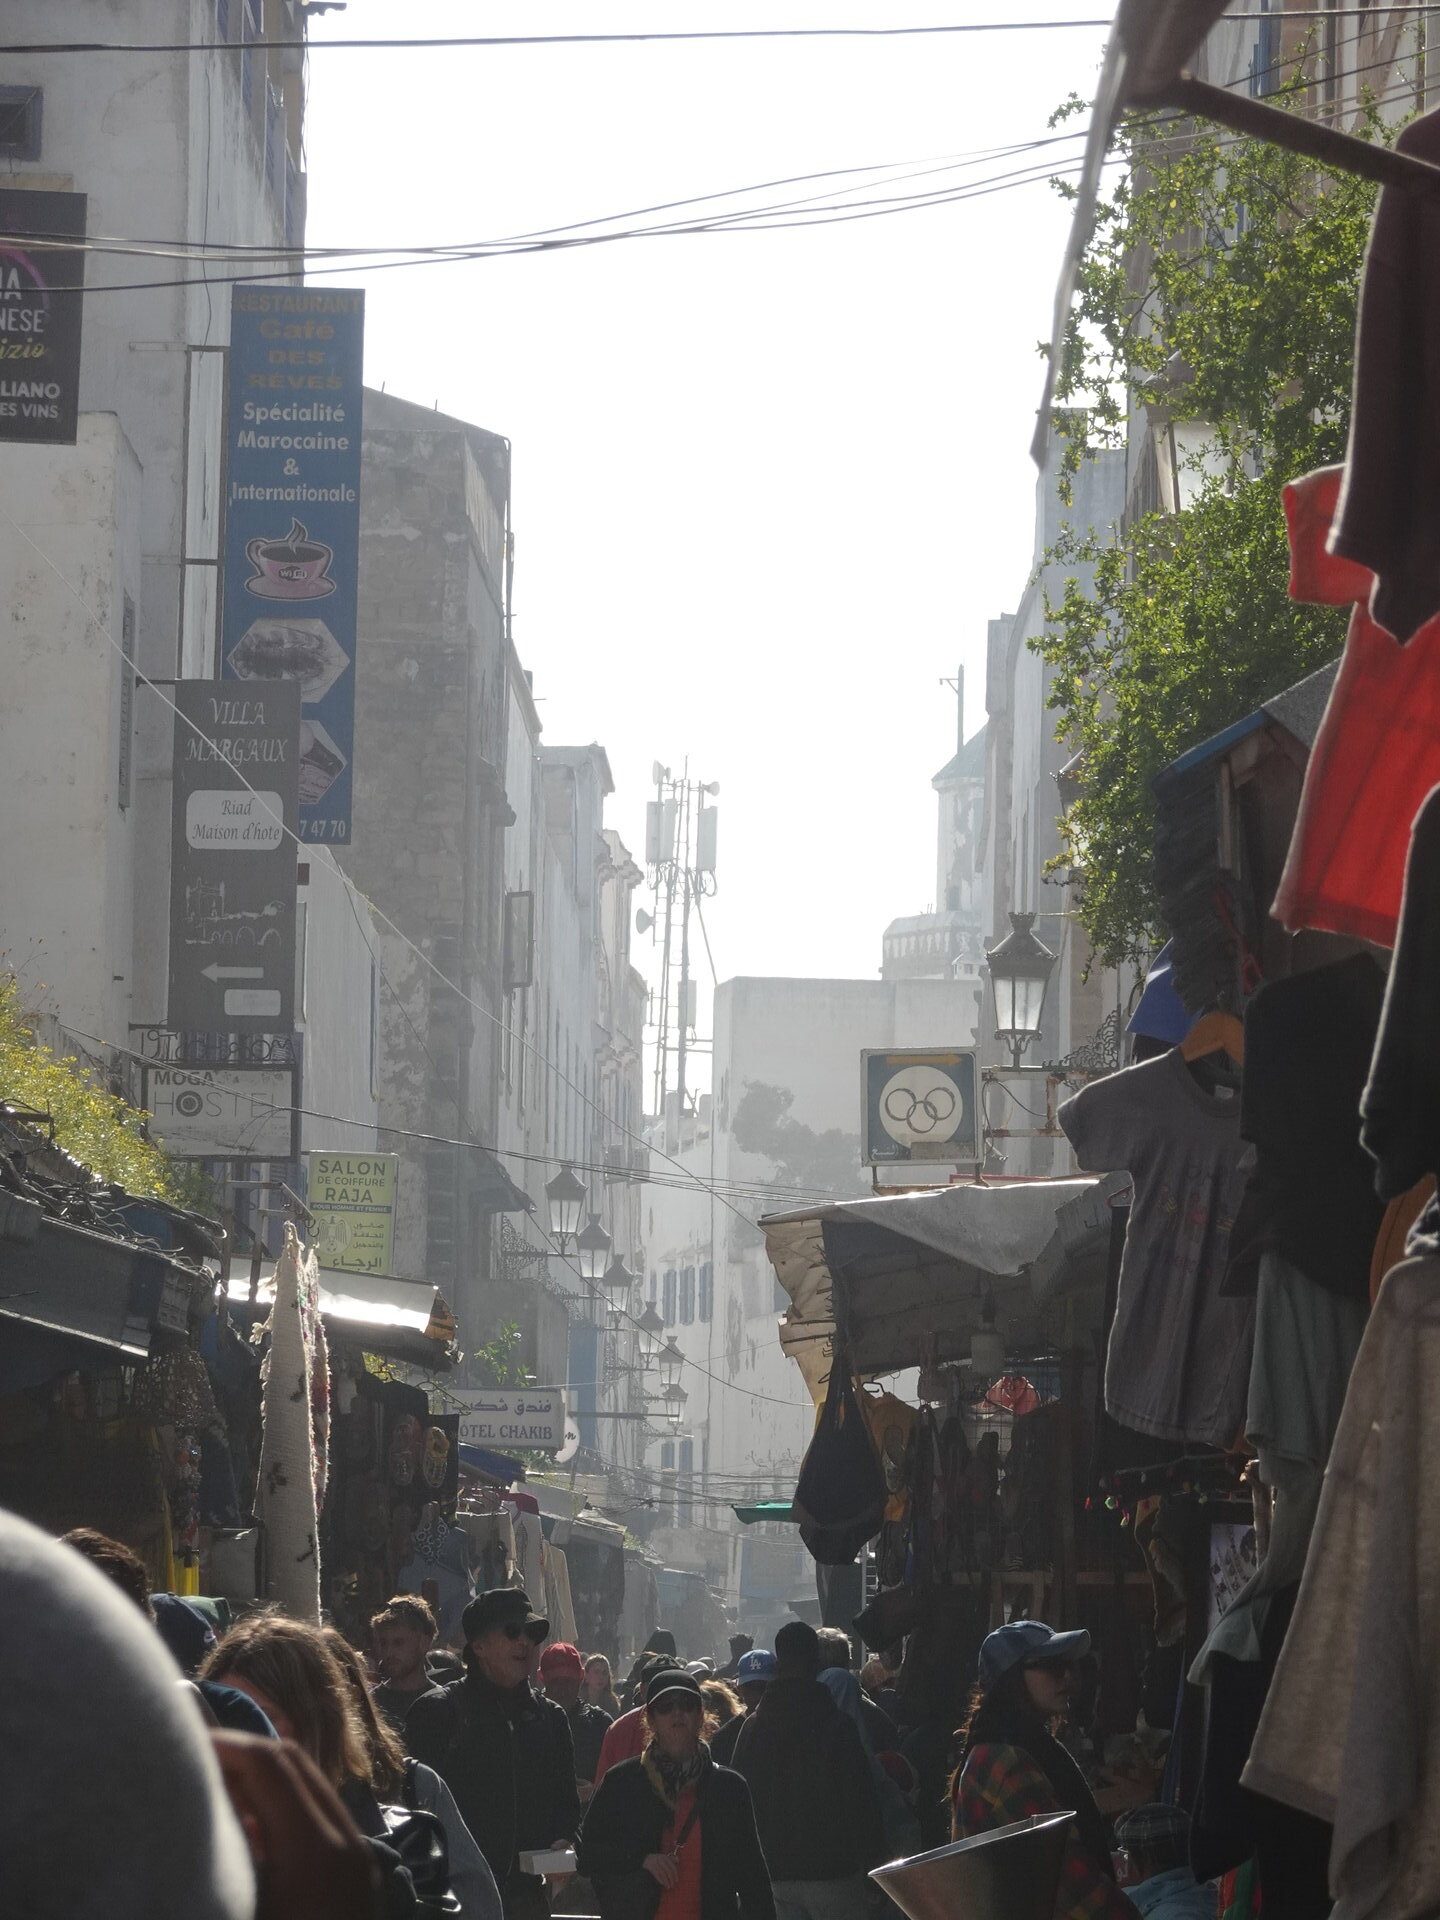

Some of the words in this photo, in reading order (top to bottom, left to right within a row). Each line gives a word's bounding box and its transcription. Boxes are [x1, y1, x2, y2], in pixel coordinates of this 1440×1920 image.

[259, 319, 335, 341] Café
[268, 350, 326, 365] DES
[22, 403, 59, 418] VINS
[242, 402, 346, 424] Spécialité
[237, 430, 350, 450] Marocaine
[283, 457, 300, 476] &
[232, 481, 356, 502] Internationale
[209, 697, 266, 726] VILLA
[184, 737, 288, 768] MARGAUX
[221, 797, 256, 817] Riad
[191, 823, 239, 841] Maison
[310, 820, 327, 837] 47
[331, 820, 347, 839] 70
[153, 1070, 215, 1087] MOGA
[153, 1090, 287, 1119] HOSTEL
[318, 1158, 386, 1176] SALON
[317, 1175, 332, 1186] DE
[334, 1176, 386, 1188] COIFFURE
[325, 1187, 374, 1203] RAJA
[514, 1399, 552, 1416] فندق
[499, 1424, 553, 1440] CHAKIB
